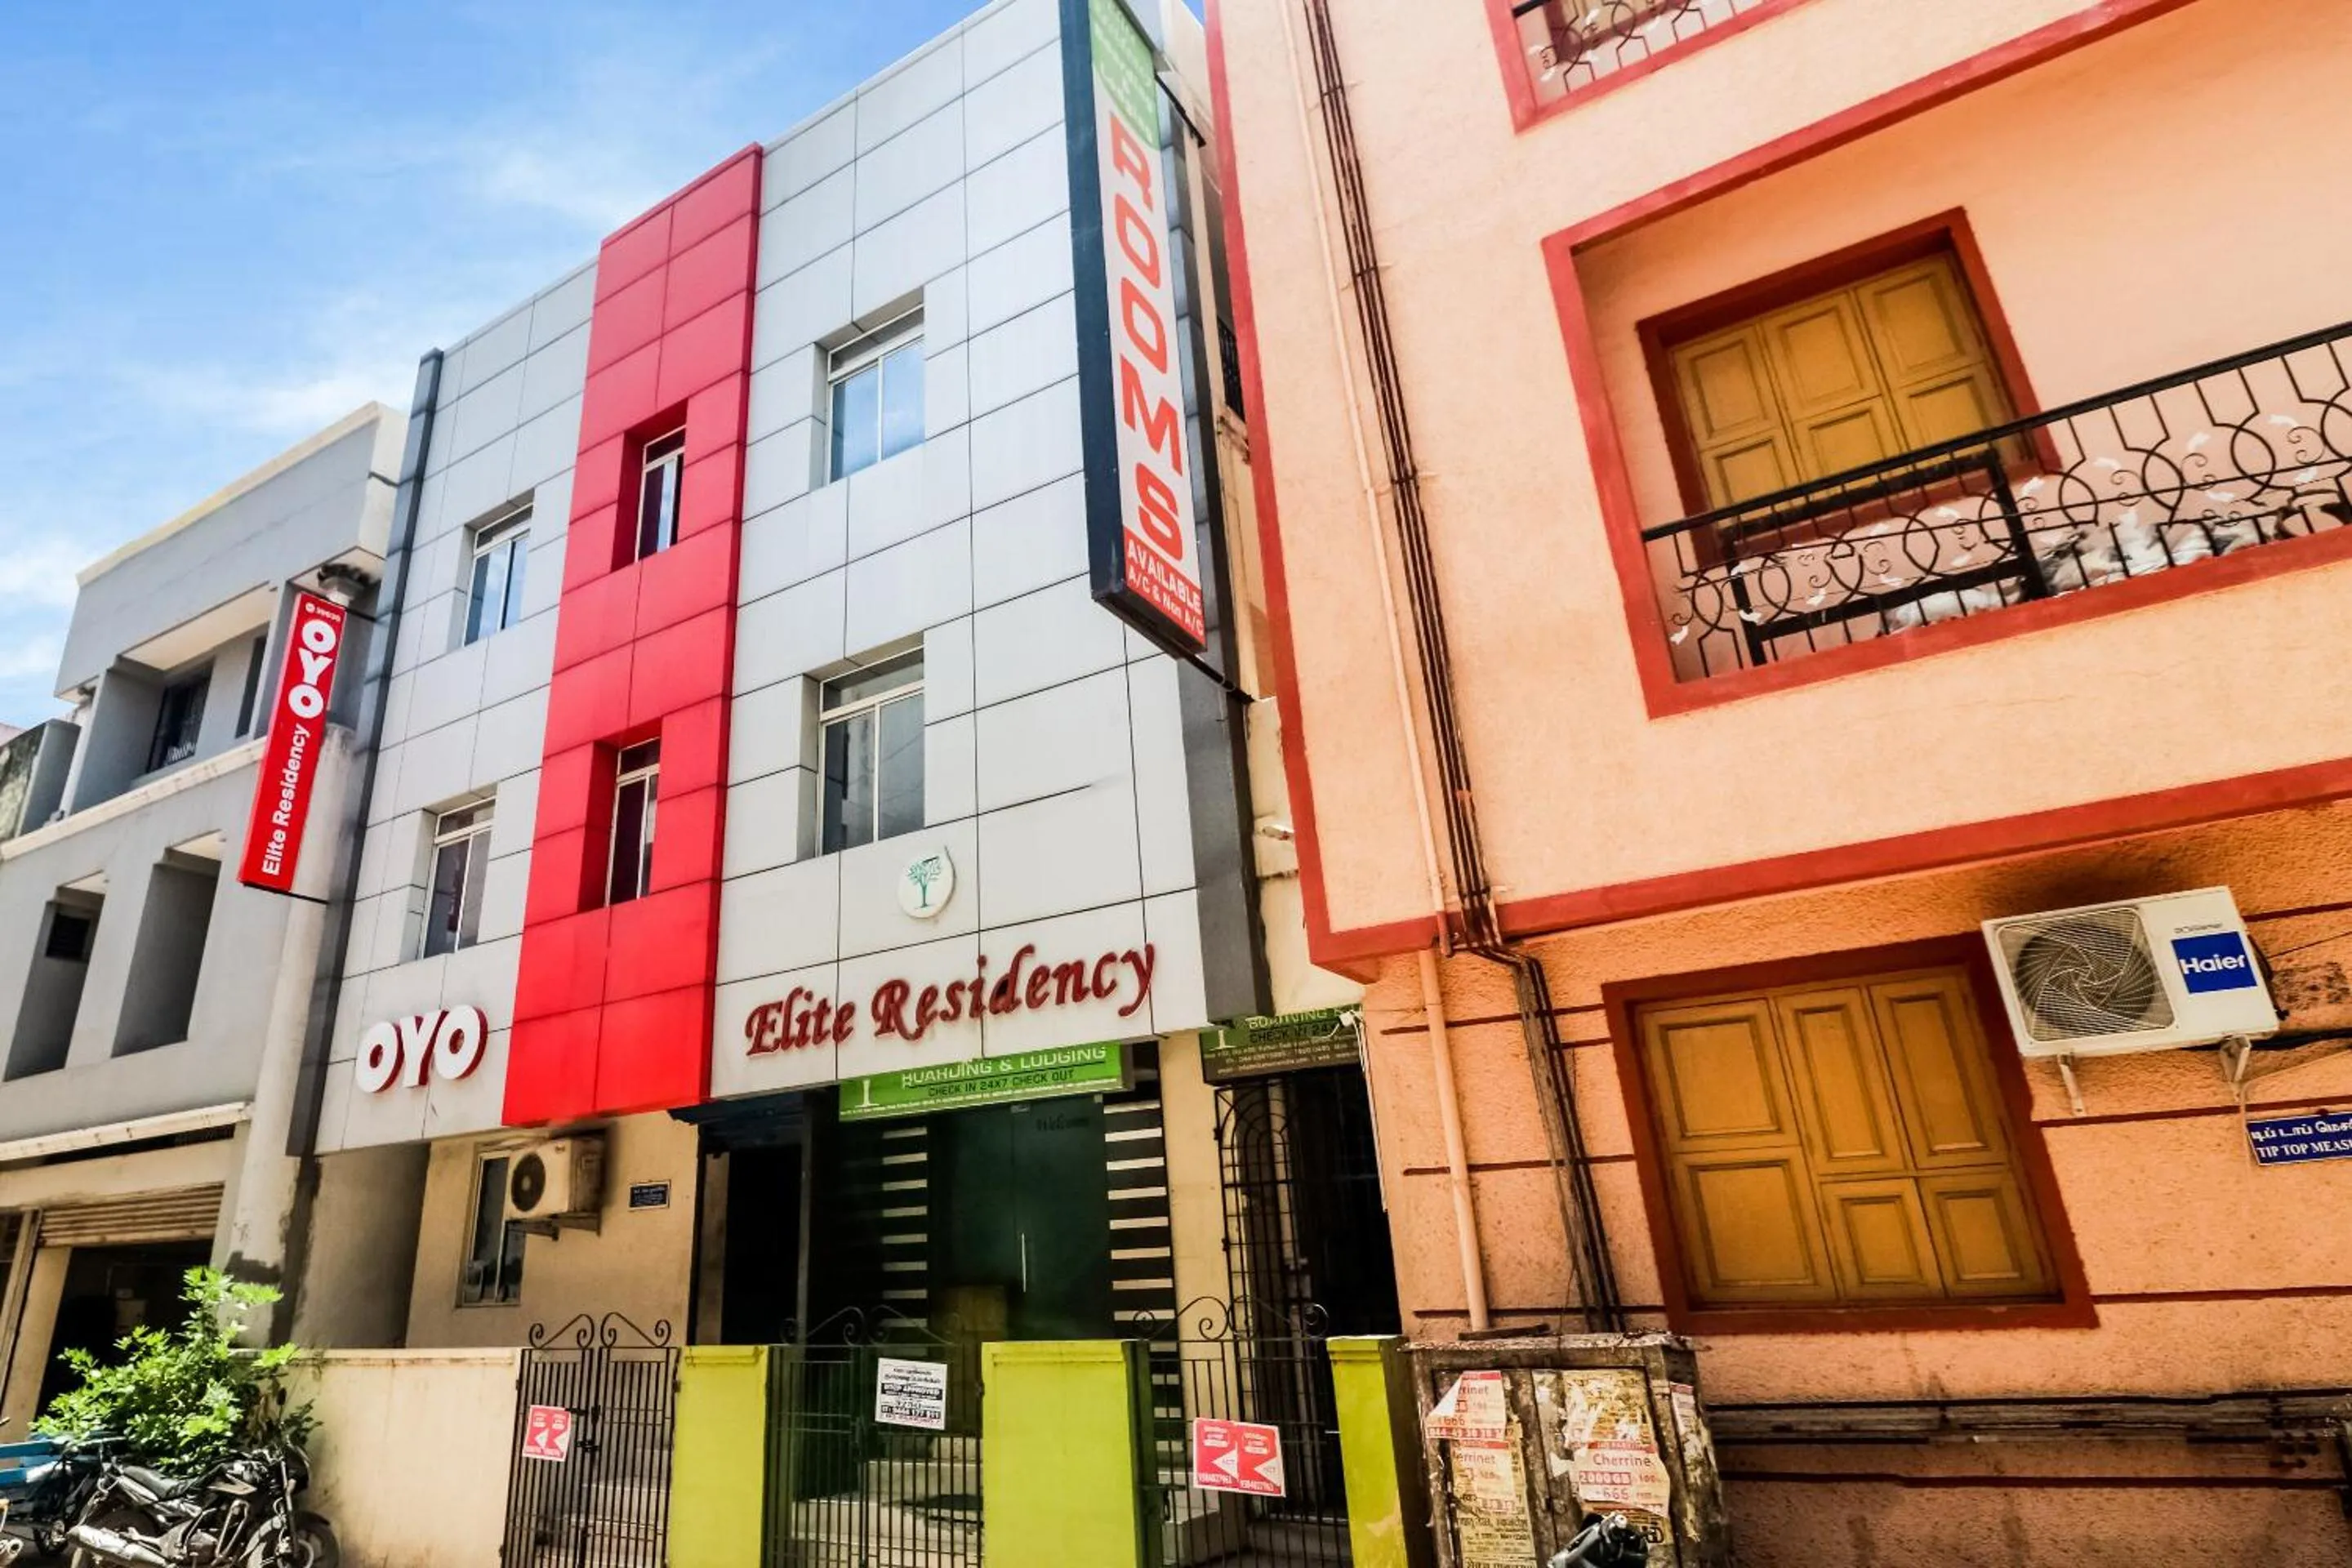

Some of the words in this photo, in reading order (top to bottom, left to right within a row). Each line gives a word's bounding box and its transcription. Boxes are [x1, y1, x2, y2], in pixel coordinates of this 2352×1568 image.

[1110, 112, 1183, 560] ROOMS
[1128, 539, 1201, 615] AVAILABLE
[1129, 564, 1150, 594] A/C
[1185, 608, 1204, 636] A/C
[288, 619, 336, 719] OYO
[272, 723, 310, 826] Residency
[261, 829, 287, 875] Elite
[745, 986, 857, 1057] Elite
[871, 942, 1156, 1041] Residency
[2180, 954, 2245, 974] Haier
[355, 1004, 488, 1094] OYO
[928, 1085, 963, 1097] CHECK
[964, 1083, 977, 1092] IN
[980, 1077, 1008, 1090] 24X7
[1012, 1073, 1048, 1087] CHECK
[1051, 1069, 1074, 1080] OUT
[2256, 1146, 2278, 1158] TIP
[2280, 1143, 2309, 1156] TOP
[1579, 1471, 1631, 1485] 2000GB
[1593, 1454, 1653, 1467] Cherrine
